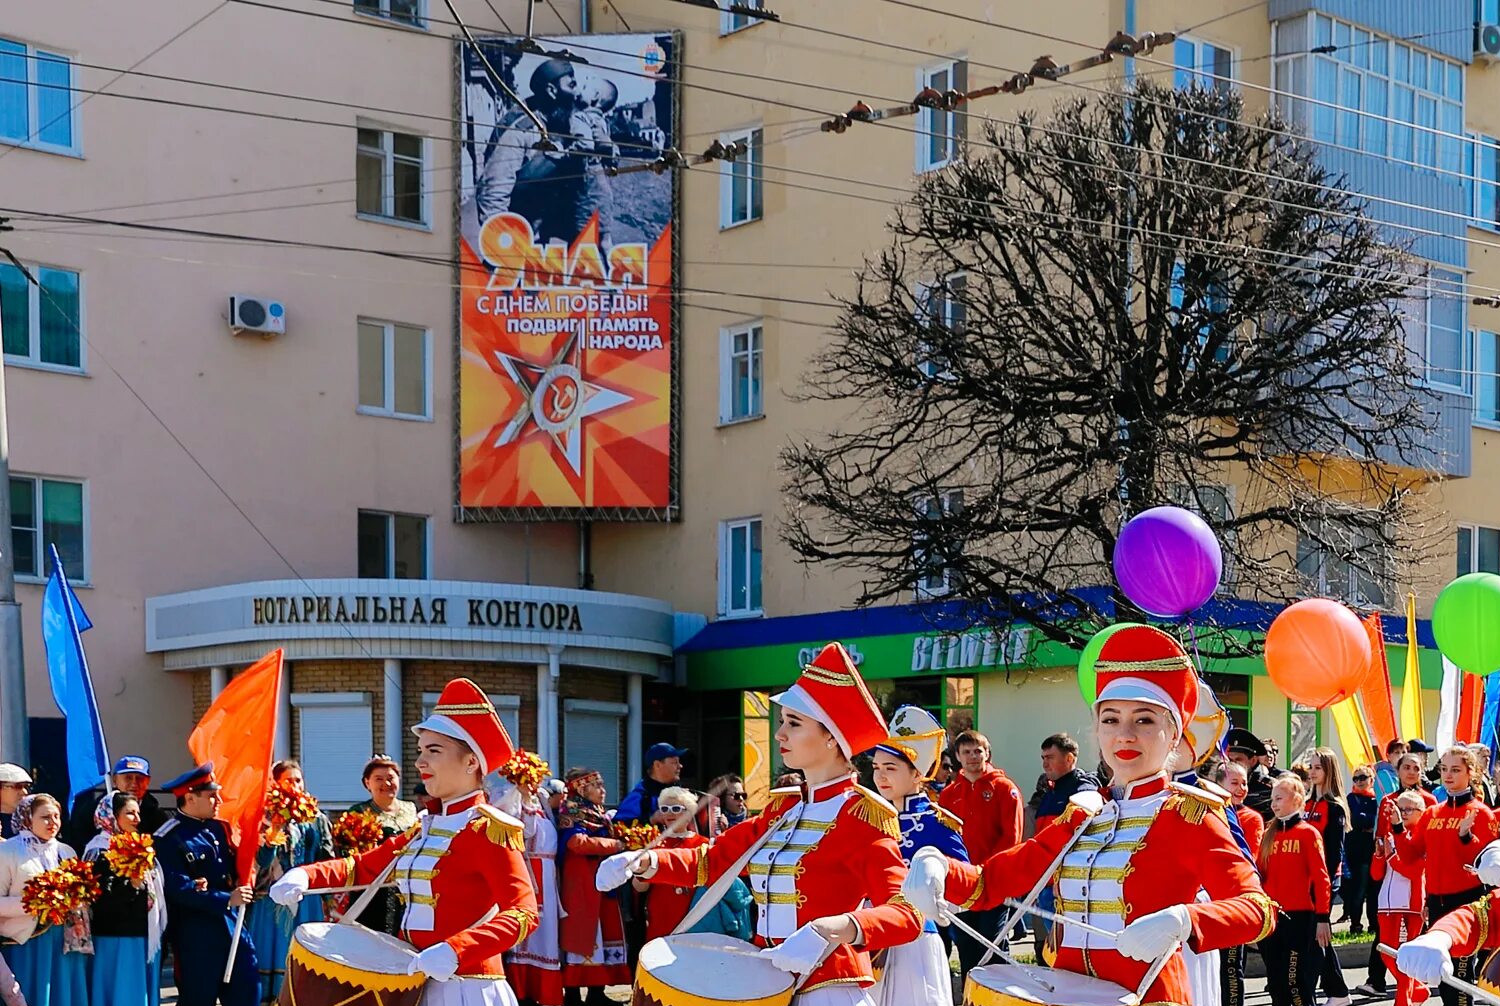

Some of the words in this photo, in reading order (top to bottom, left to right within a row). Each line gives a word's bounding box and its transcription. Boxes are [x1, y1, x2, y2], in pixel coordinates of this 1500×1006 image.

[477, 296, 490, 314] С
[494, 296, 550, 316] ДНЕМ
[556, 294, 649, 315] ПОБЕДЫ!
[507, 318, 579, 335] ПОДВИГ
[589, 317, 660, 333] ПАМЯТЬ
[589, 335, 663, 351] НАРОДА
[253, 596, 447, 625] НОТАРИАЛЬНАЯ
[467, 598, 583, 632] КОНТОРА
[1288, 950, 1298, 986] AEROBIC
[1458, 956, 1469, 978] OBIC
